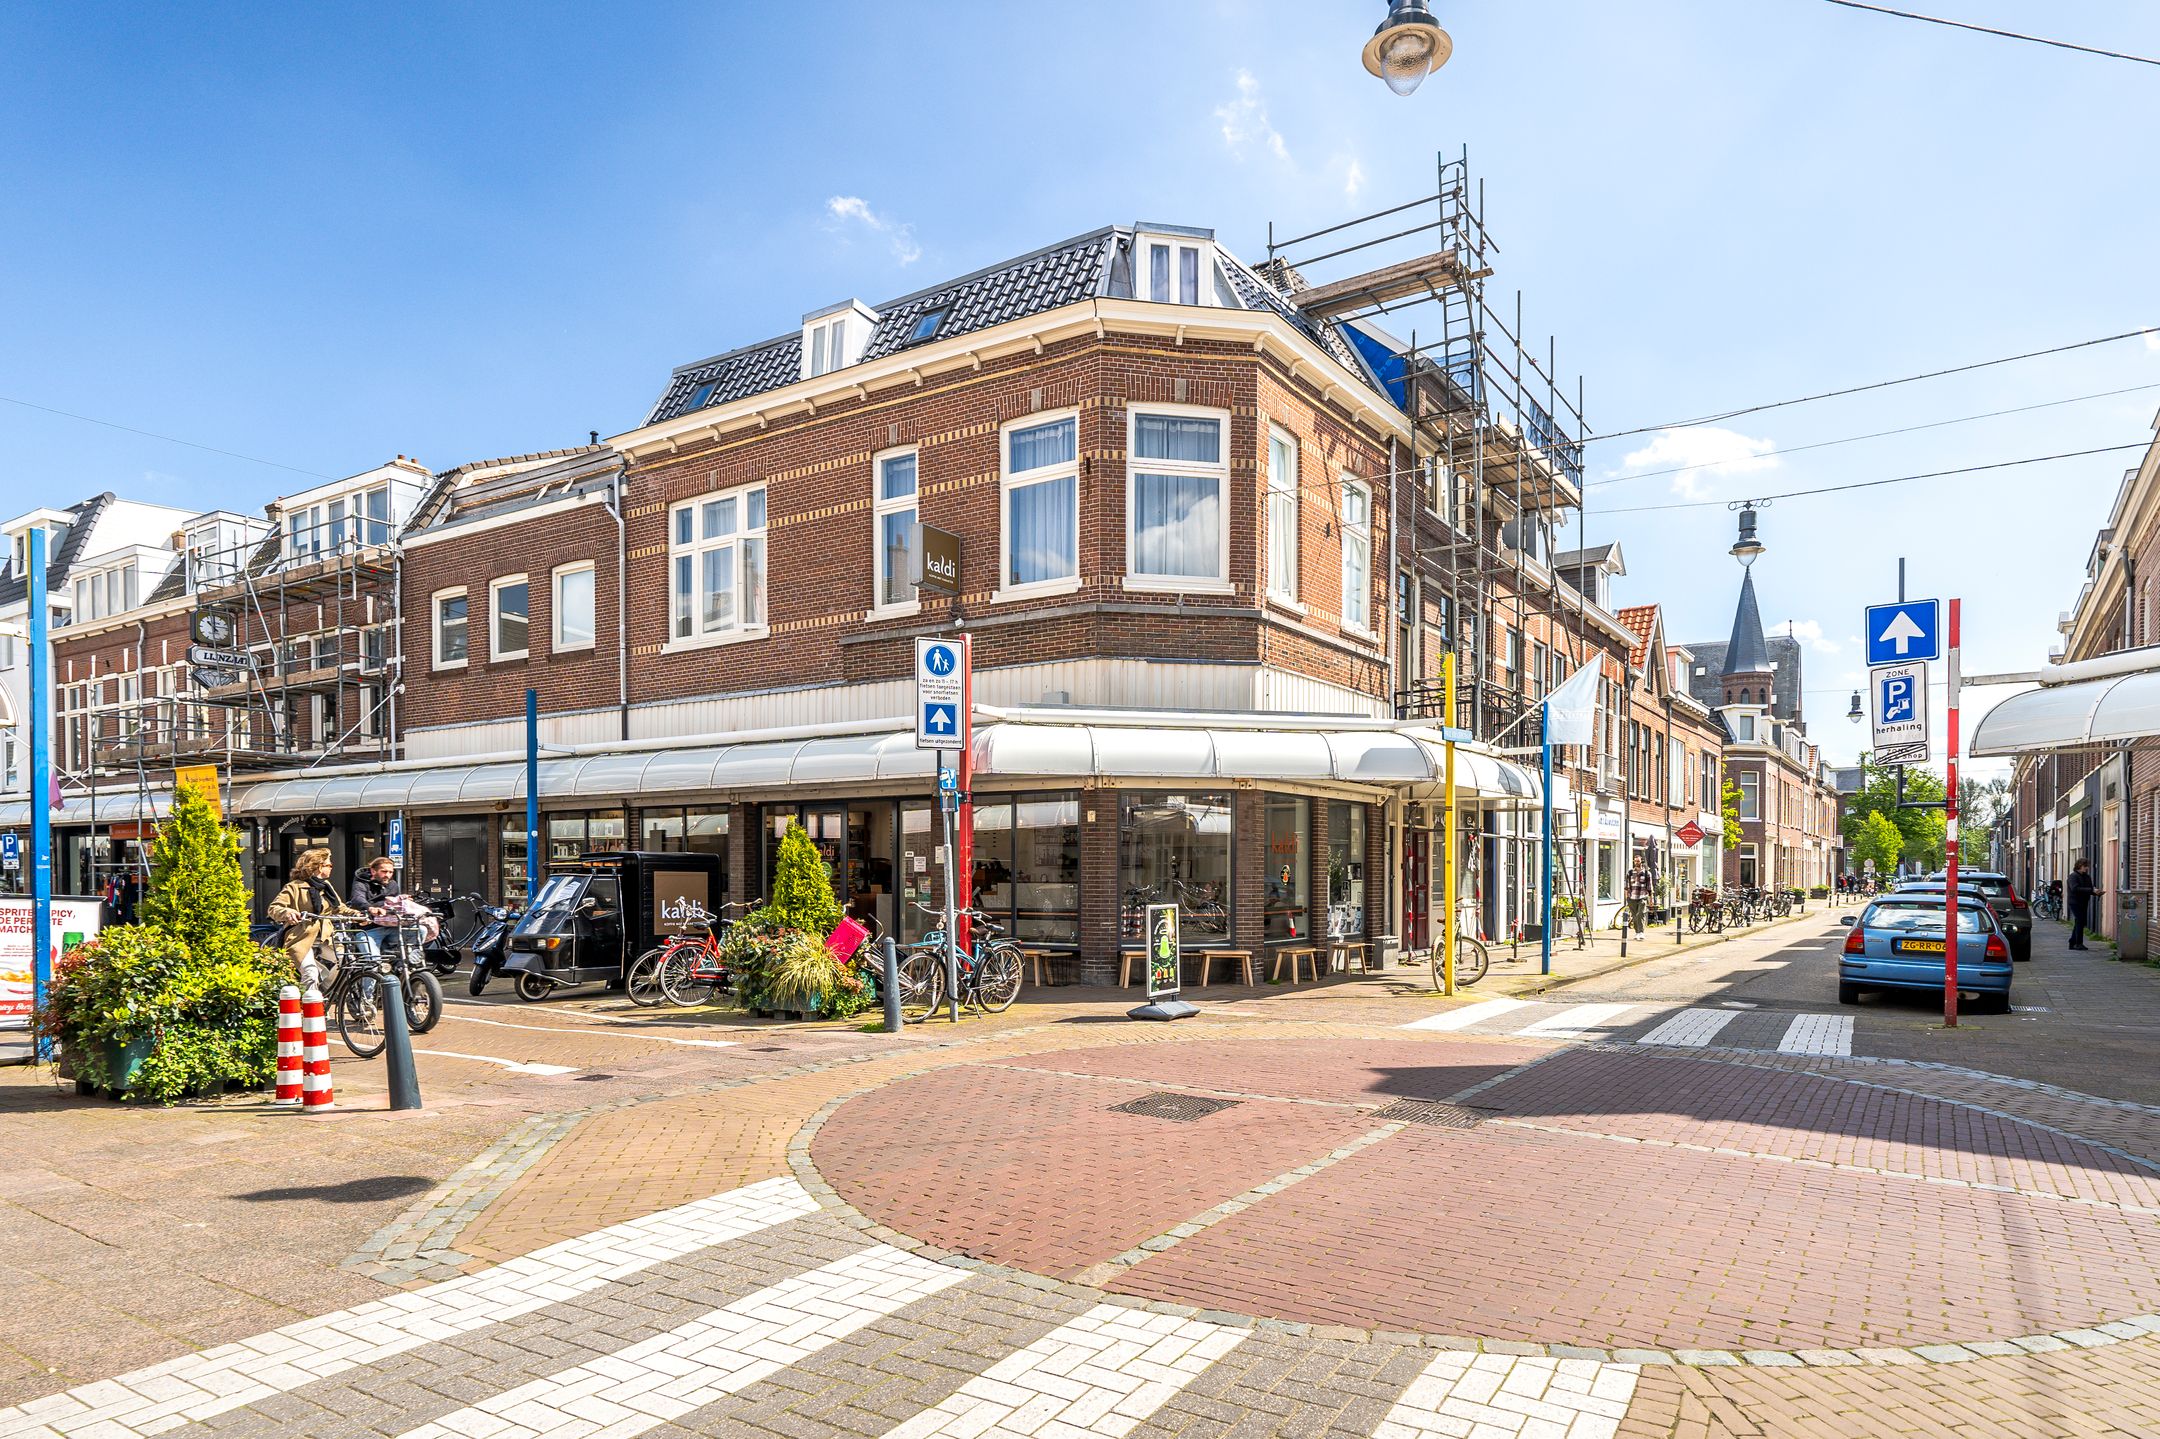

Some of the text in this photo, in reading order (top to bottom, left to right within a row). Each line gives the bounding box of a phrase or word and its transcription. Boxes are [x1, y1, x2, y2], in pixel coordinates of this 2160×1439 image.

[927, 552, 955, 578] kaldi
[1886, 669, 1909, 678] ZONE
[1889, 681, 1906, 704] P
[1876, 724, 1922, 734] herhaling
[6, 836, 14, 849] P
[50, 910, 76, 919] PICY,
